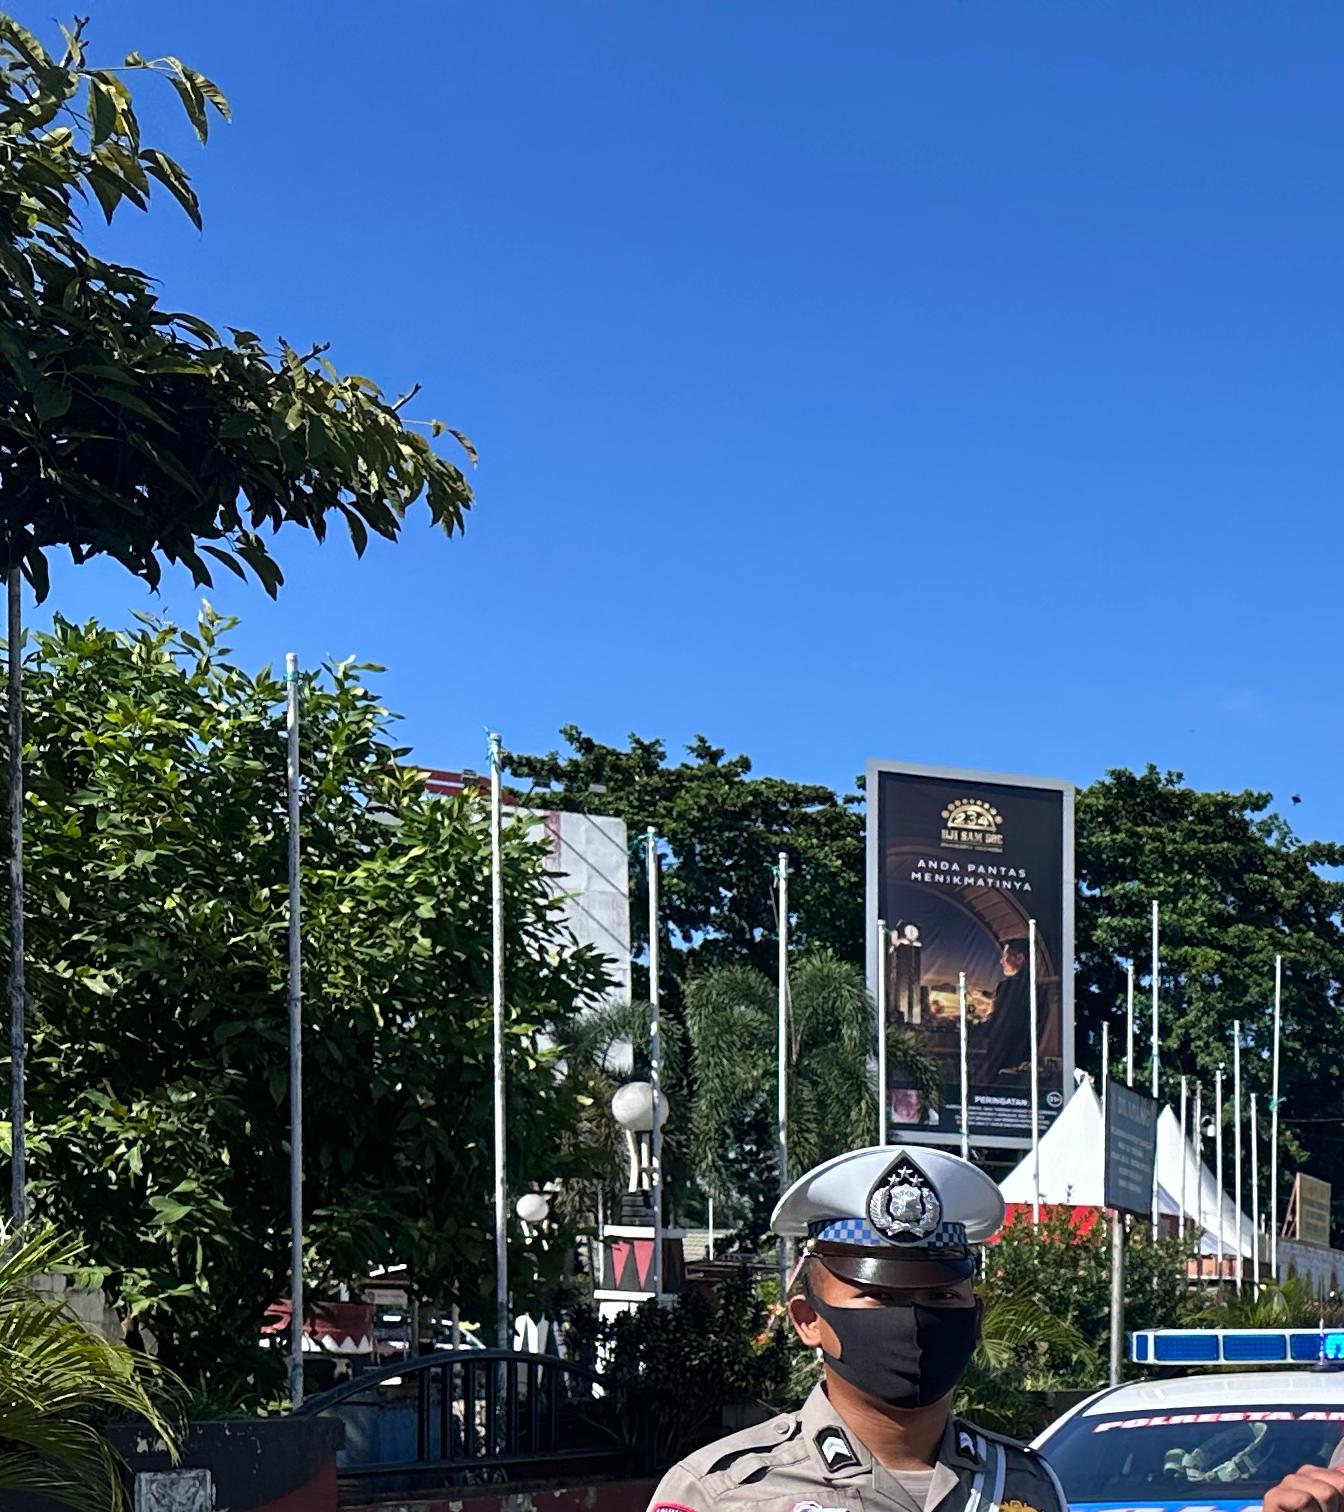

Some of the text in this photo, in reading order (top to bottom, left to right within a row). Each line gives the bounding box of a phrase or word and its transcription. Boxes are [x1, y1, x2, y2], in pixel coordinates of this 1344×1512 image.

[917, 858, 1026, 878] ANDA PANTAS
[911, 872, 1031, 891] MENIKMATINYA
[1092, 1412, 1295, 1433] POLRESTA
